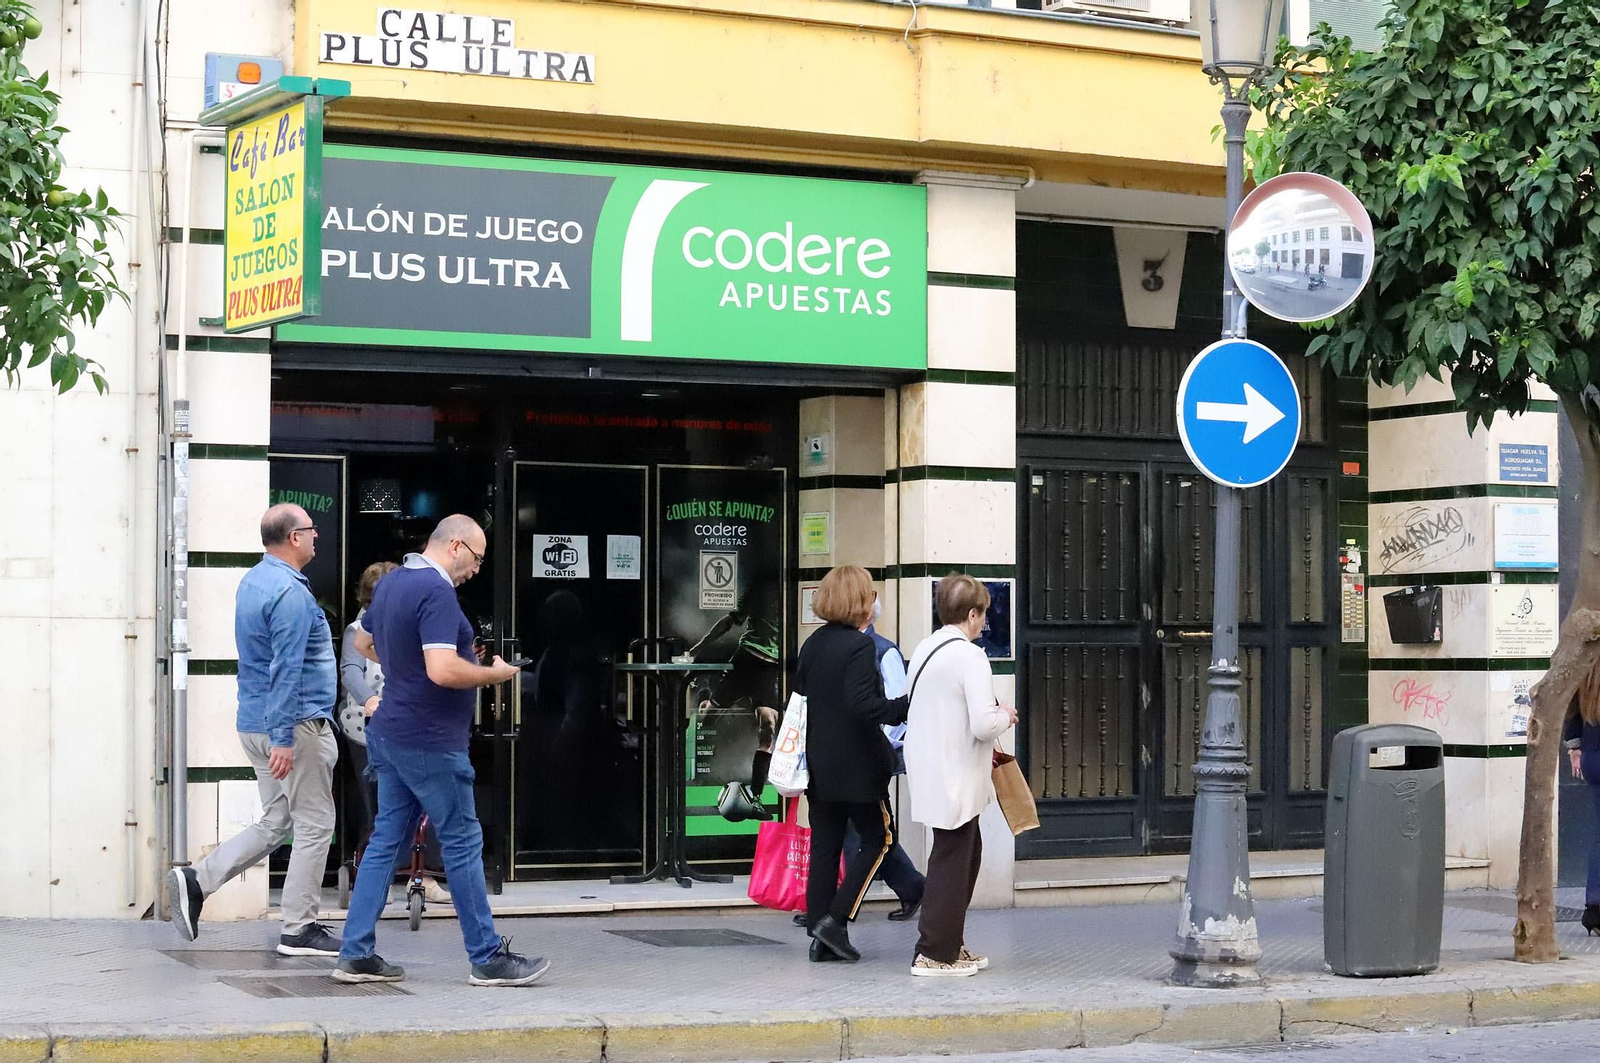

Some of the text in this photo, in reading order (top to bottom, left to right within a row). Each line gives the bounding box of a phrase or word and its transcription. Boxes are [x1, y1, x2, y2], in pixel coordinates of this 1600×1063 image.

[381, 9, 512, 47] CALLE
[324, 33, 593, 83] PLUS ULTRA
[230, 112, 305, 180] Café Bar
[235, 173, 295, 216] SALON
[252, 212, 276, 243] DE
[321, 203, 583, 244] ALÓN DE JUEGO
[231, 237, 298, 282] JUEGOS
[320, 248, 571, 290] PLUS ULTRA
[682, 221, 892, 279] codere
[1142, 248, 1170, 292] 3
[227, 274, 303, 321] PLUS ULTRA
[719, 281, 892, 316] APUESTAS
[671, 418, 722, 431] menores
[666, 498, 775, 523] ¿QUIÉN SE APUNTA?
[694, 522, 747, 536] codere
[548, 536, 573, 544] ZONA
[703, 538, 748, 546] APUESTAS
[544, 569, 577, 577] GRATIS
